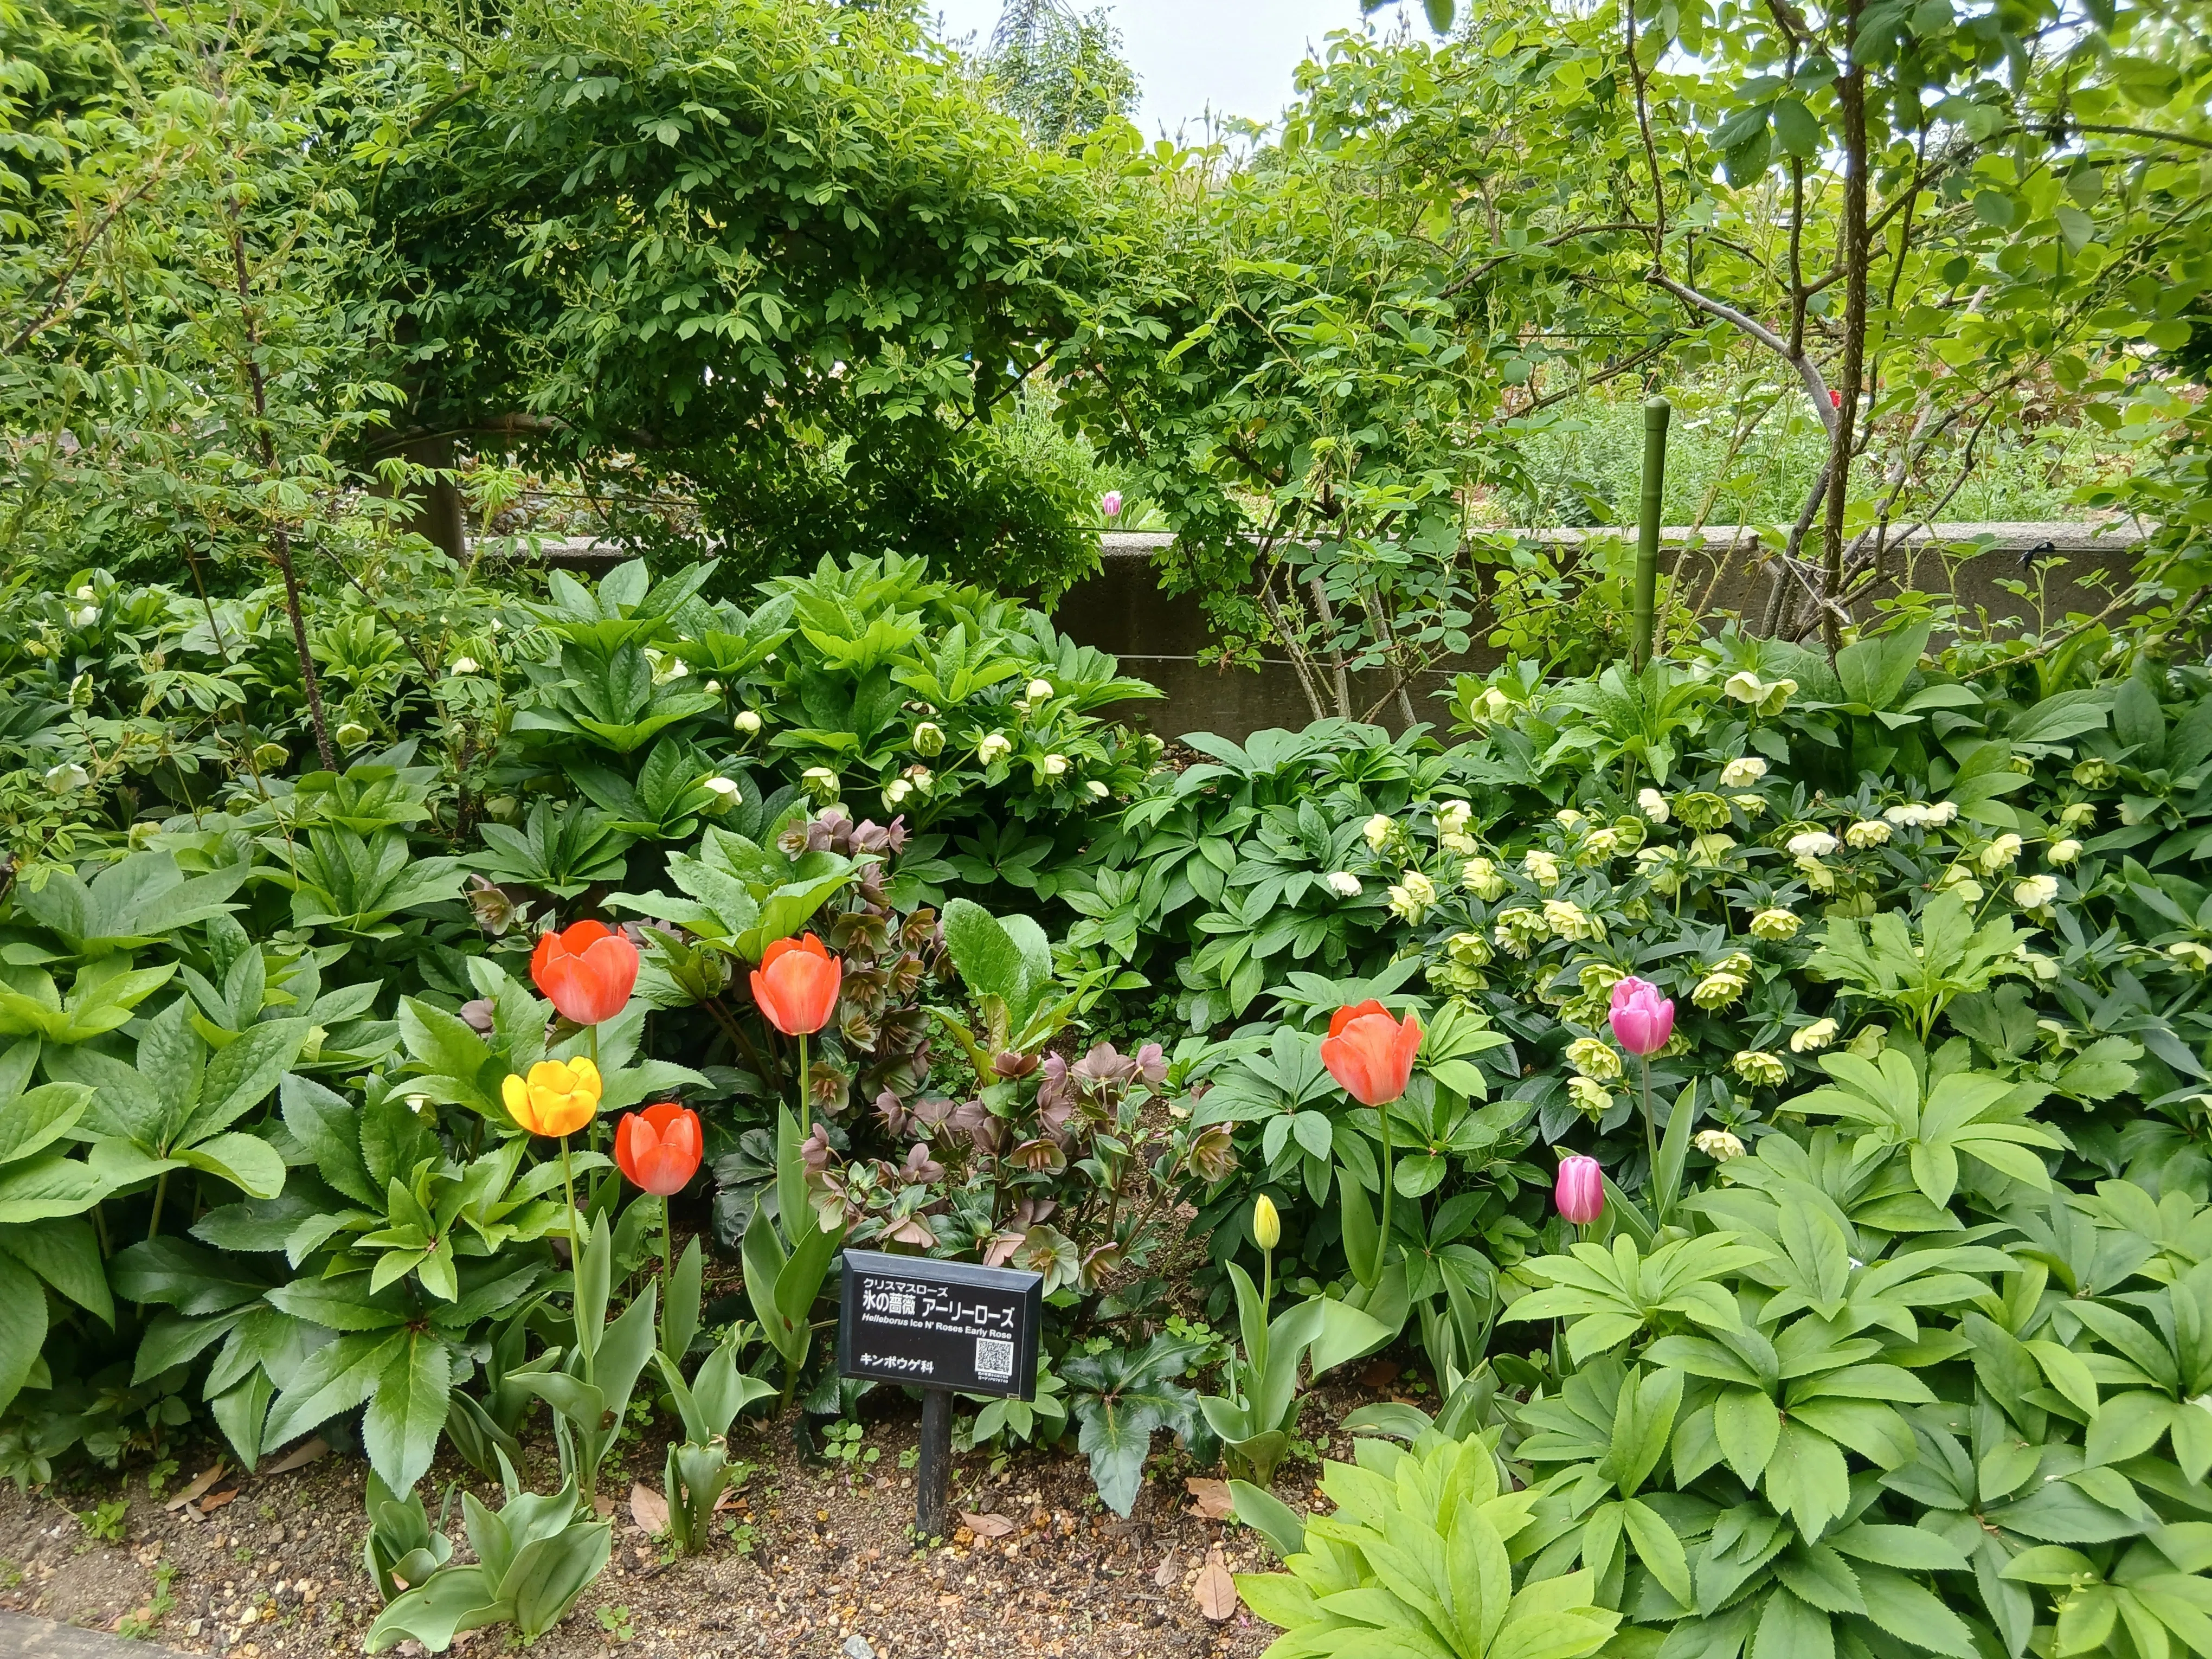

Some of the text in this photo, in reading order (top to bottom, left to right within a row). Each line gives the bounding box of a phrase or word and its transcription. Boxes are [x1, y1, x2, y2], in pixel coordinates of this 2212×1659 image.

[863, 1278, 949, 1298] クリスマスローズ
[863, 1289, 1015, 1328] 氷の薔薇 アーリーローズ
[861, 1313, 909, 1326] Helleborus
[910, 1319, 923, 1328] Ice
[936, 1322, 963, 1333] Roses
[965, 1326, 988, 1338] Early
[989, 1329, 1012, 1340] Rose
[860, 1353, 935, 1375] キンポウゲ科
